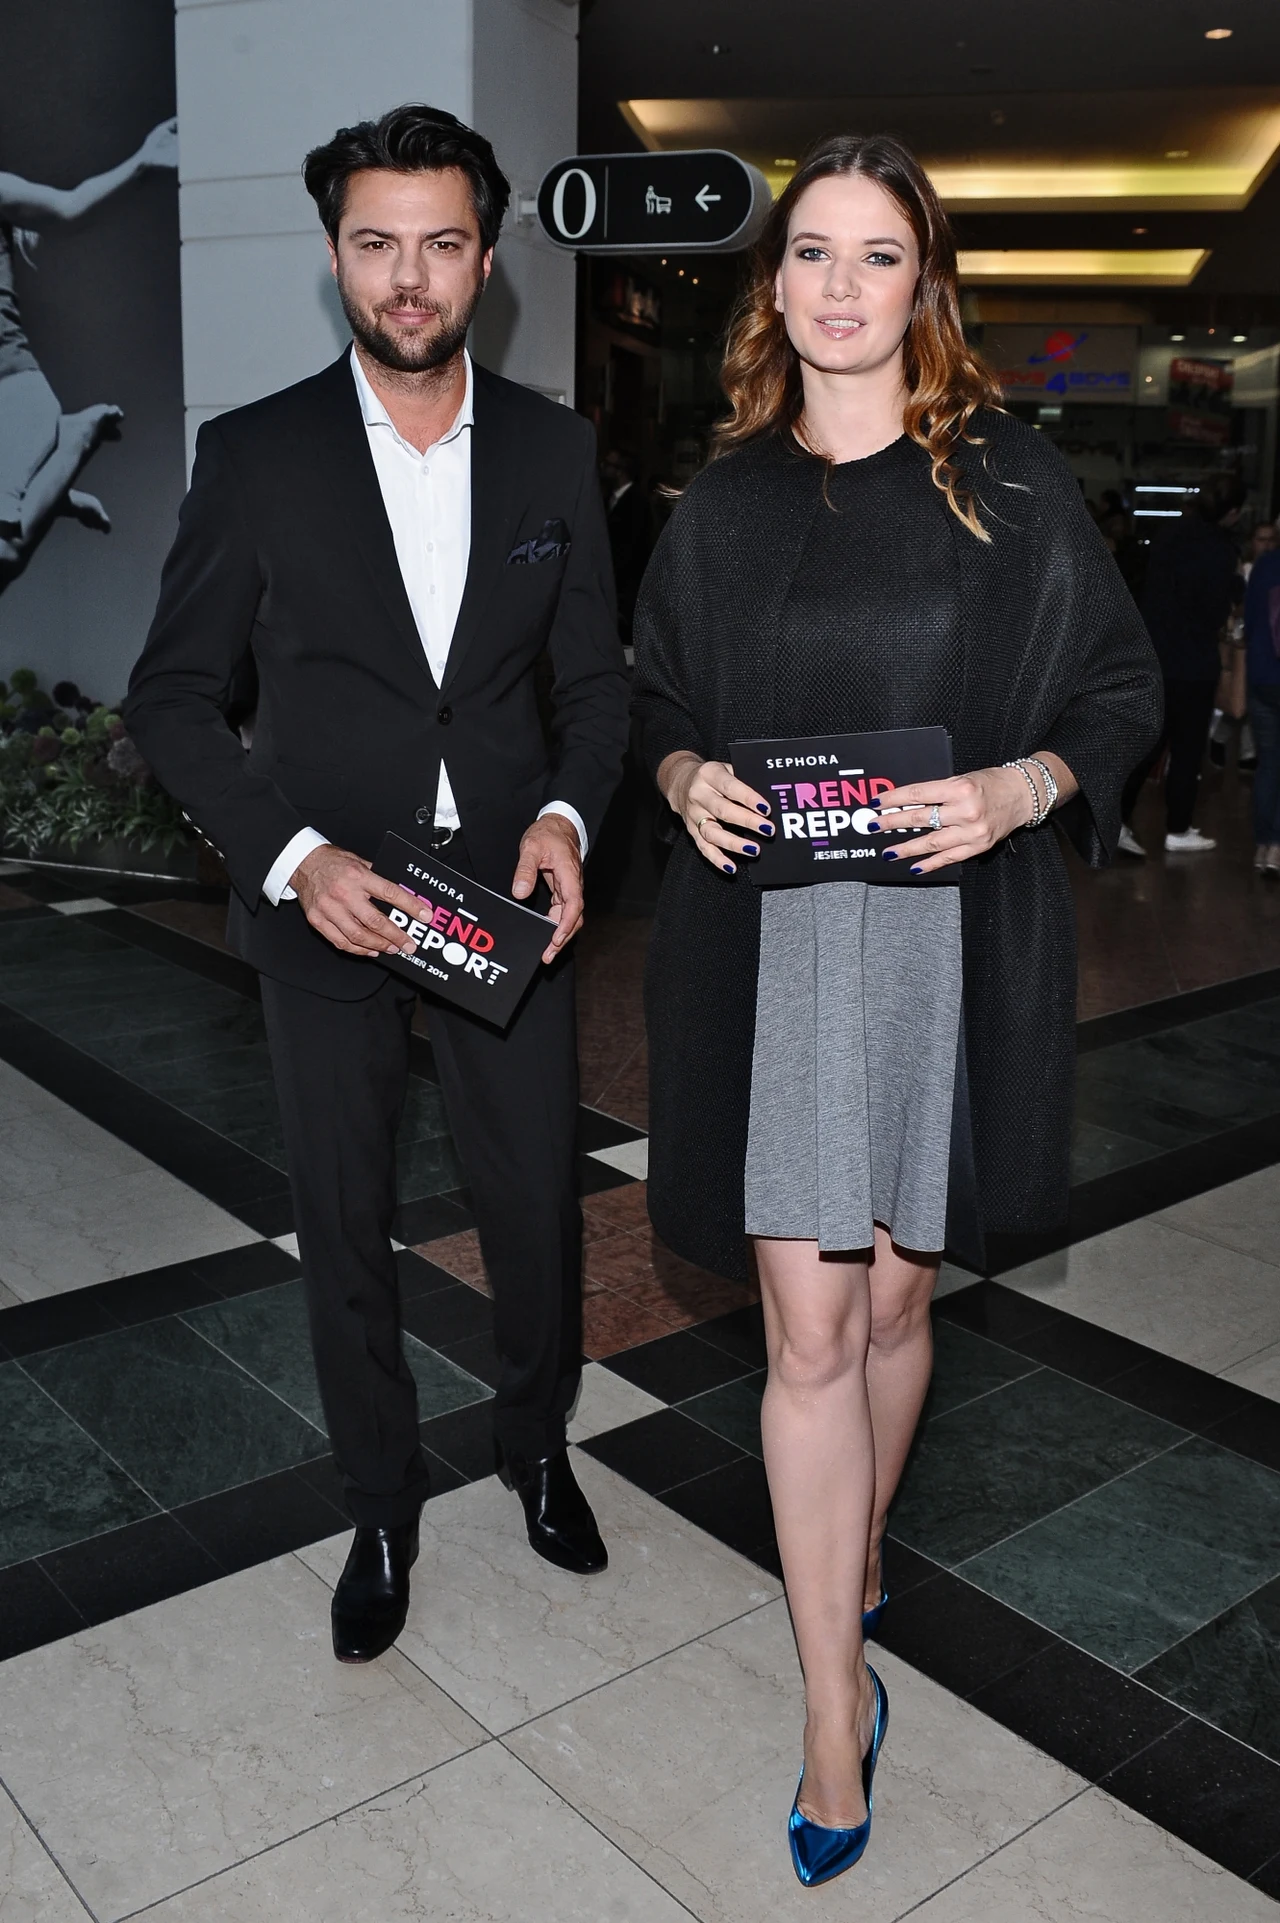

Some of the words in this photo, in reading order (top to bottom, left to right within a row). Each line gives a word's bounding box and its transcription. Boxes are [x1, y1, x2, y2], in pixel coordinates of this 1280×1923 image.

[766, 754, 840, 769] SEPHORA
[770, 777, 896, 811] TREND
[849, 848, 877, 859] 2014
[406, 863, 465, 903] SEPHORA
[398, 883, 495, 953] END
[426, 964, 449, 981] 2014
